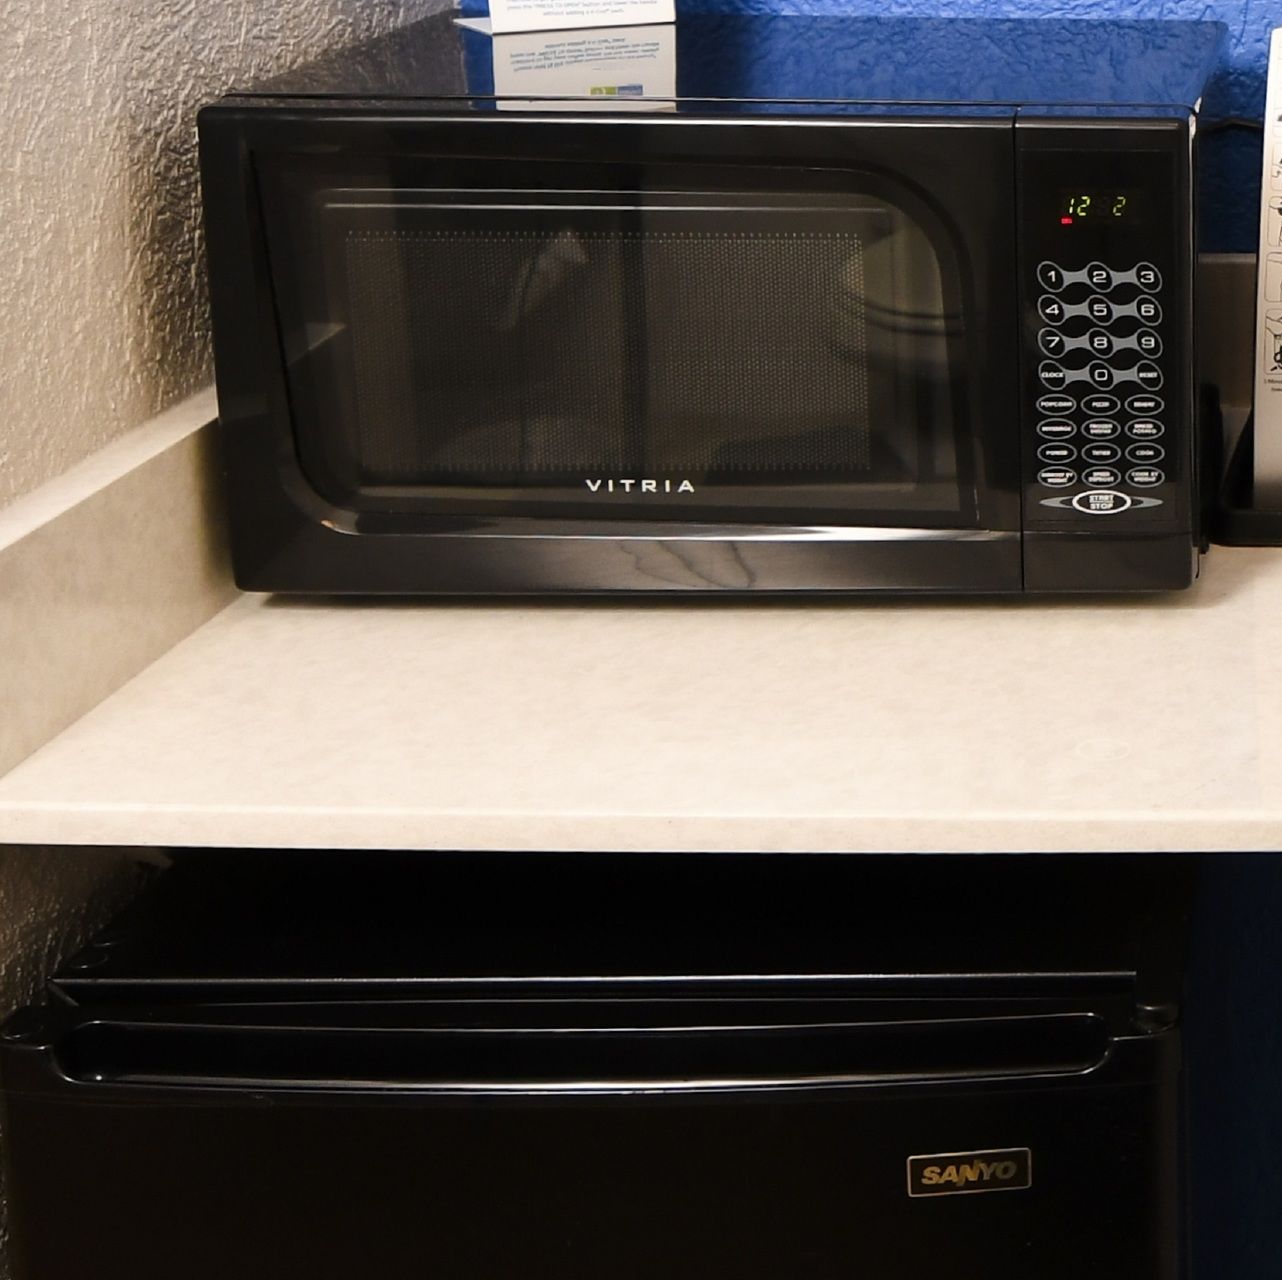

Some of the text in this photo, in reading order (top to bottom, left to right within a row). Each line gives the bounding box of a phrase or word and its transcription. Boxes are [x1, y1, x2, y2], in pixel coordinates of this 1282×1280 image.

[1047, 270, 1056, 282] 1
[1092, 270, 1107, 283] 2
[1140, 271, 1154, 283] 3
[1045, 304, 1060, 315] 4
[1093, 304, 1107, 316] 5
[1141, 304, 1155, 316] 6
[1045, 336, 1060, 348] 7
[1093, 336, 1108, 349] 8
[1141, 337, 1155, 349] 9
[1094, 369, 1108, 381] 0
[585, 479, 695, 493] VITRIA
[1089, 494, 1114, 503] START
[921, 1159, 1017, 1187] SANYO
